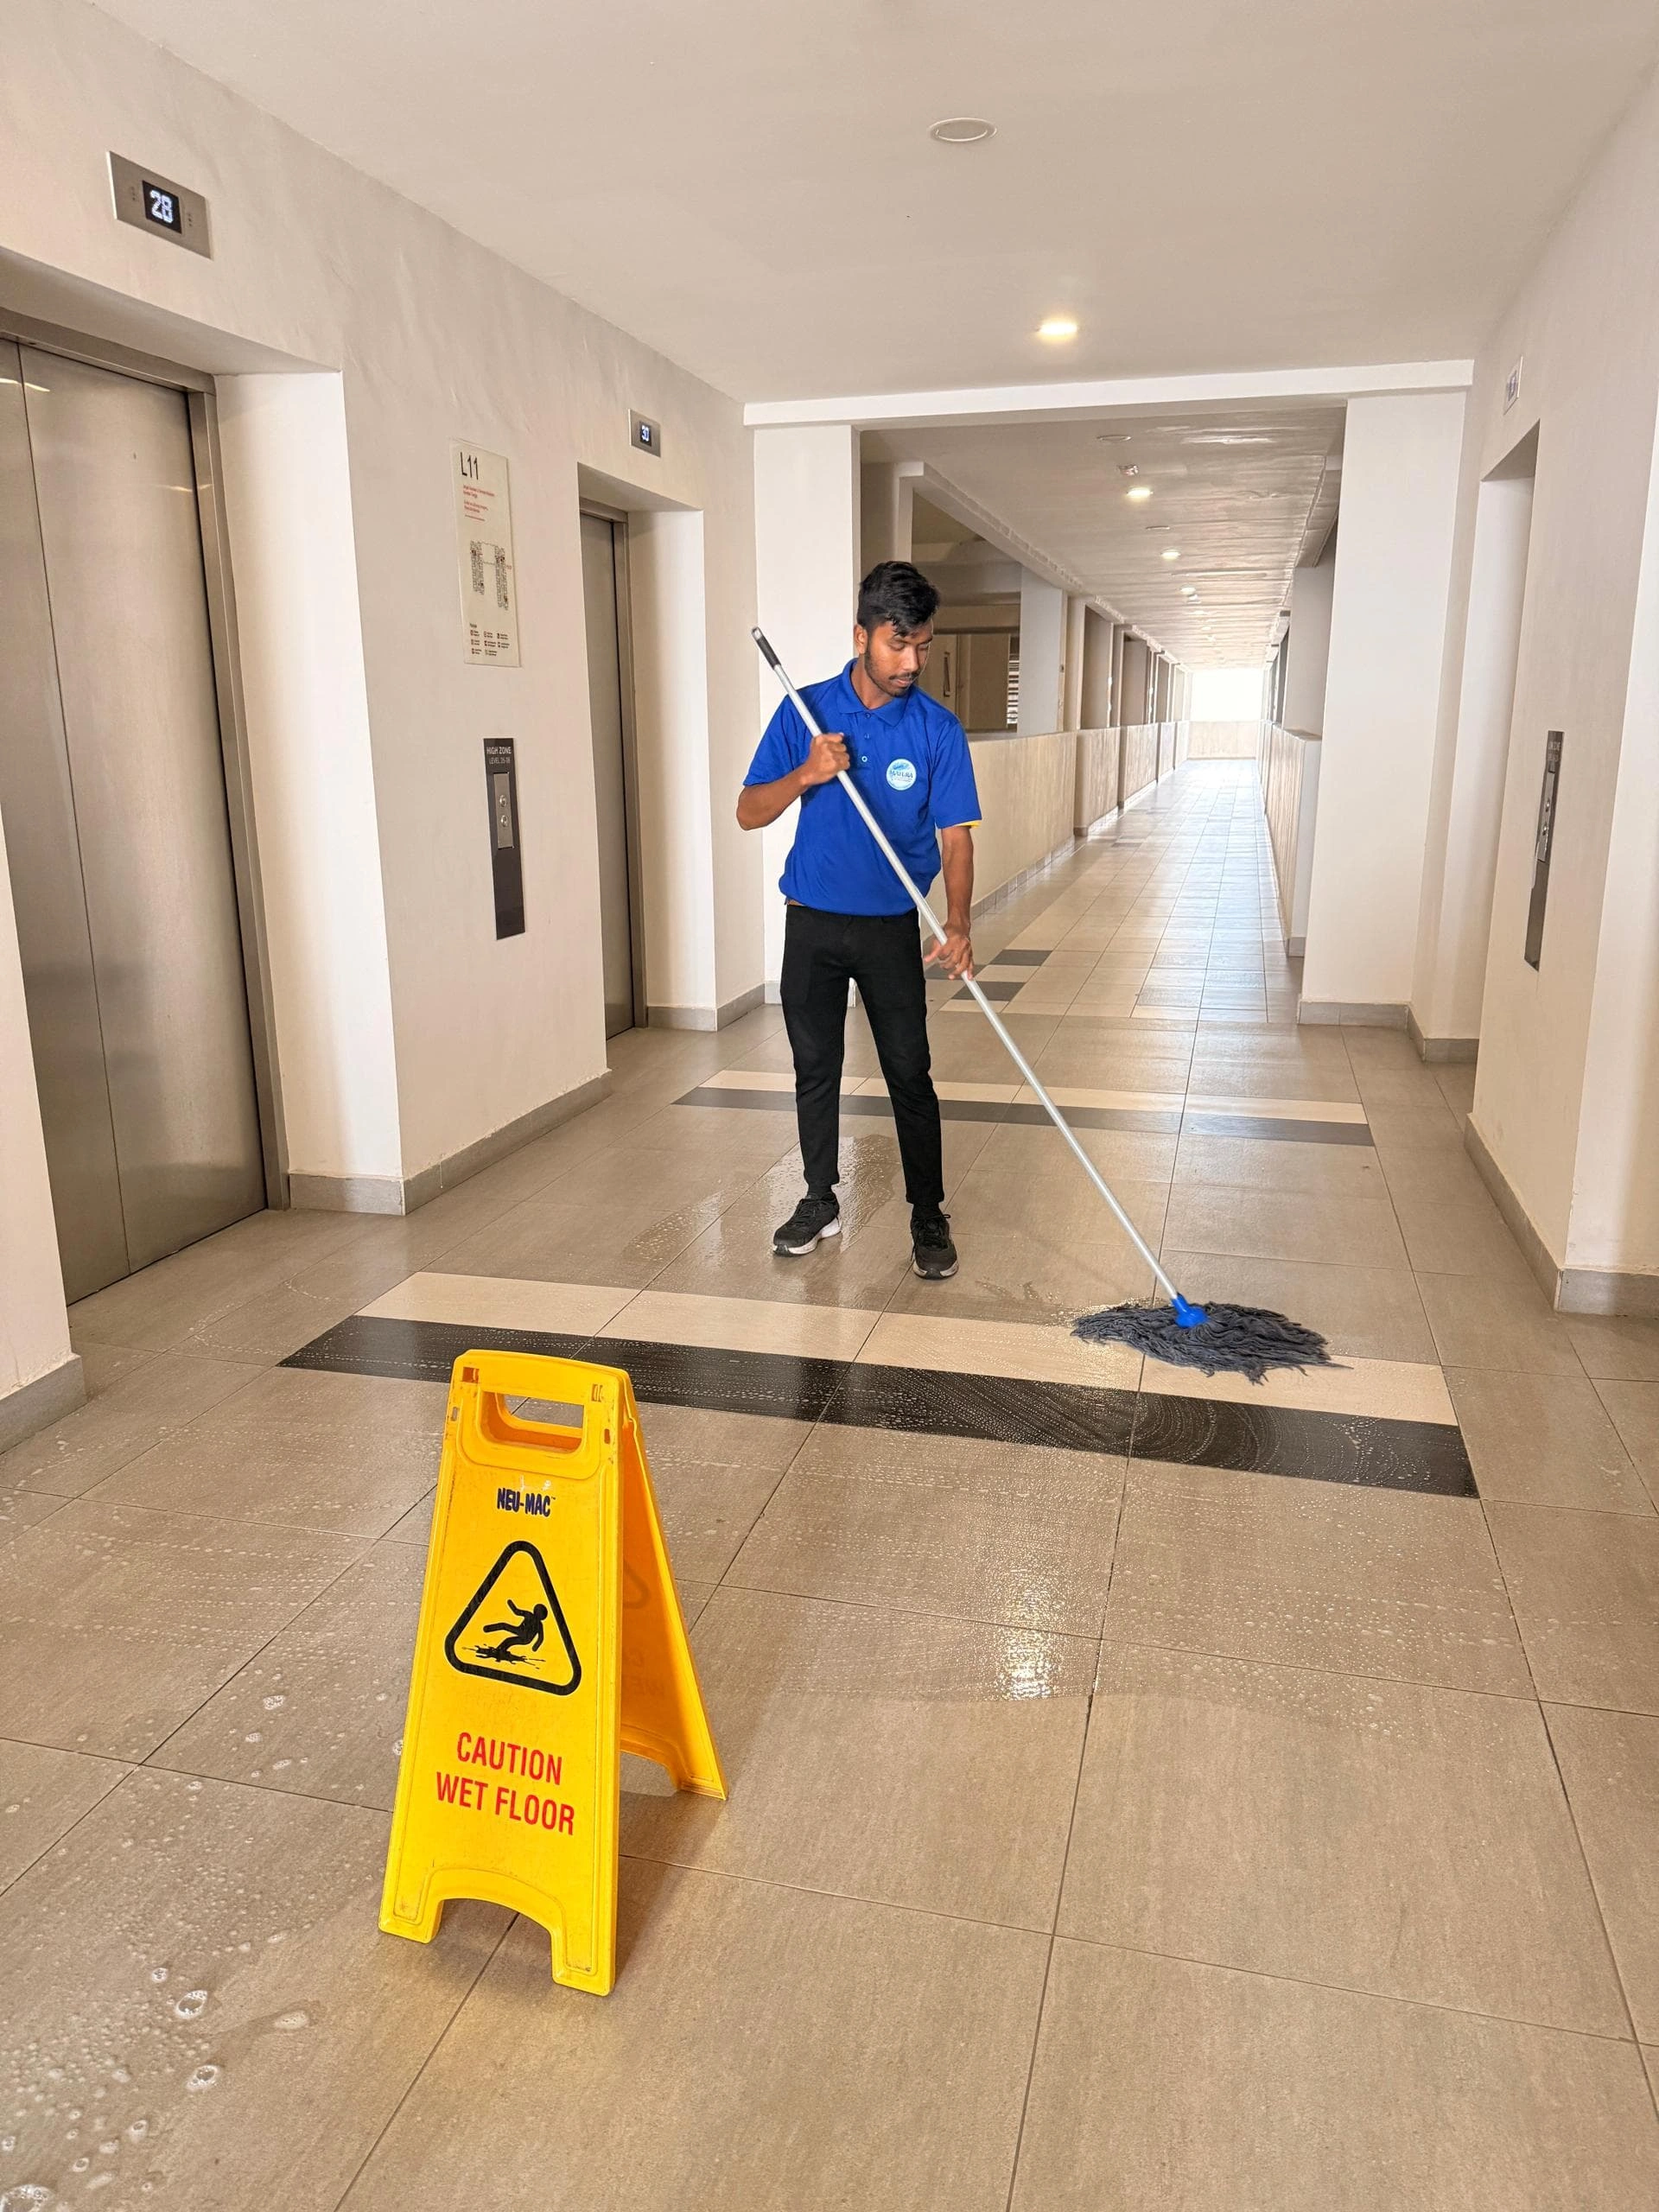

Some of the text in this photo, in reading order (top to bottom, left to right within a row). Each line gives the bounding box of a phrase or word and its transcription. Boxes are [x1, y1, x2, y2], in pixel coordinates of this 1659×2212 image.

[460, 452, 479, 480] L11
[457, 1732, 563, 1785] CAUTION
[436, 1771, 575, 1835] WET FLOOR
